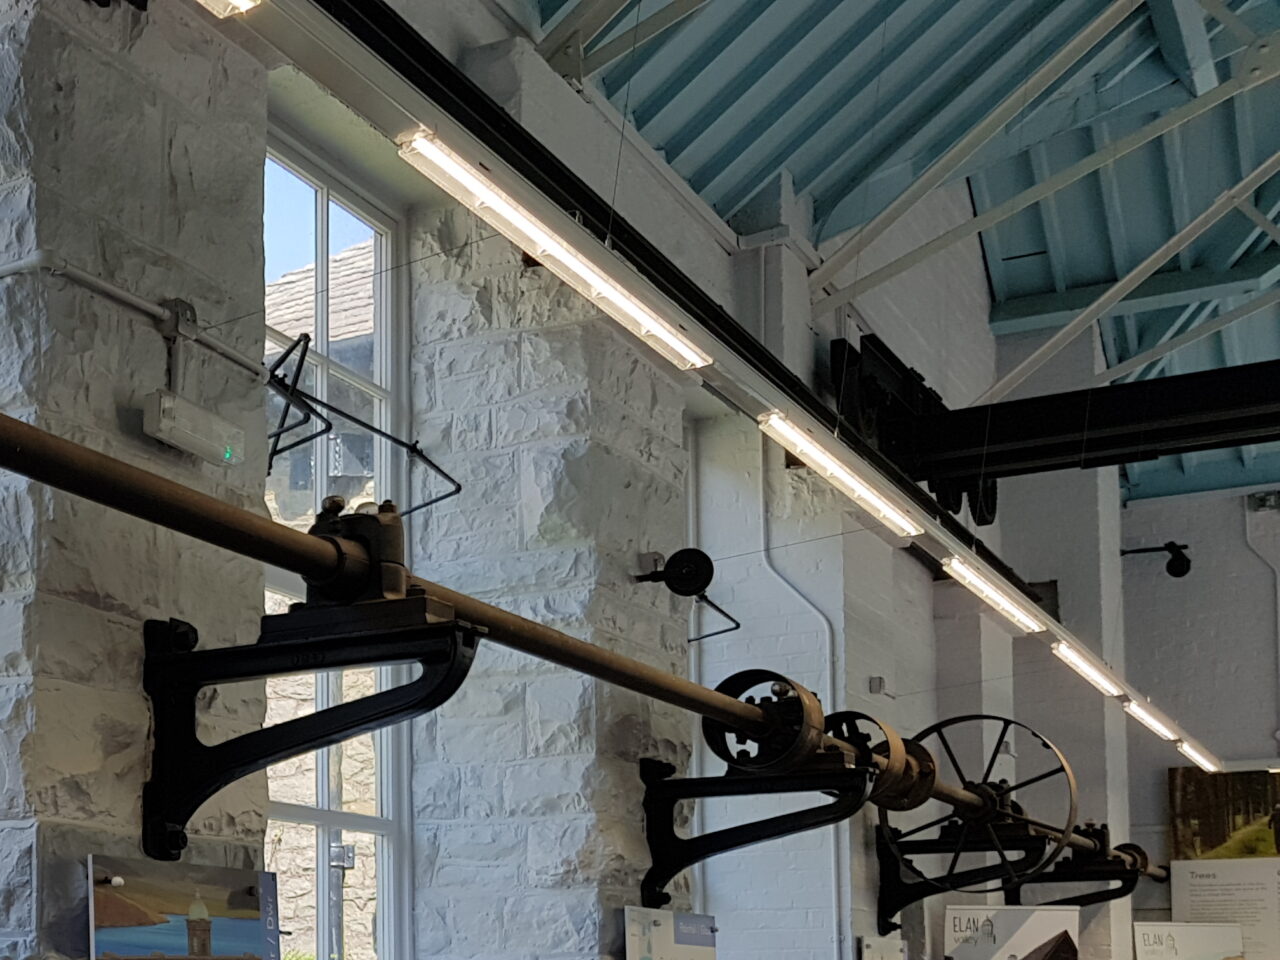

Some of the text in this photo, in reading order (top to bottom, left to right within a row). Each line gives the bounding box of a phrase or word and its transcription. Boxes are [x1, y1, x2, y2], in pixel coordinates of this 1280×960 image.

[1190, 871, 1216, 879] Trees
[953, 916, 979, 933] ELAN
[953, 935, 978, 946] valley
[1143, 933, 1164, 947] ELAN
